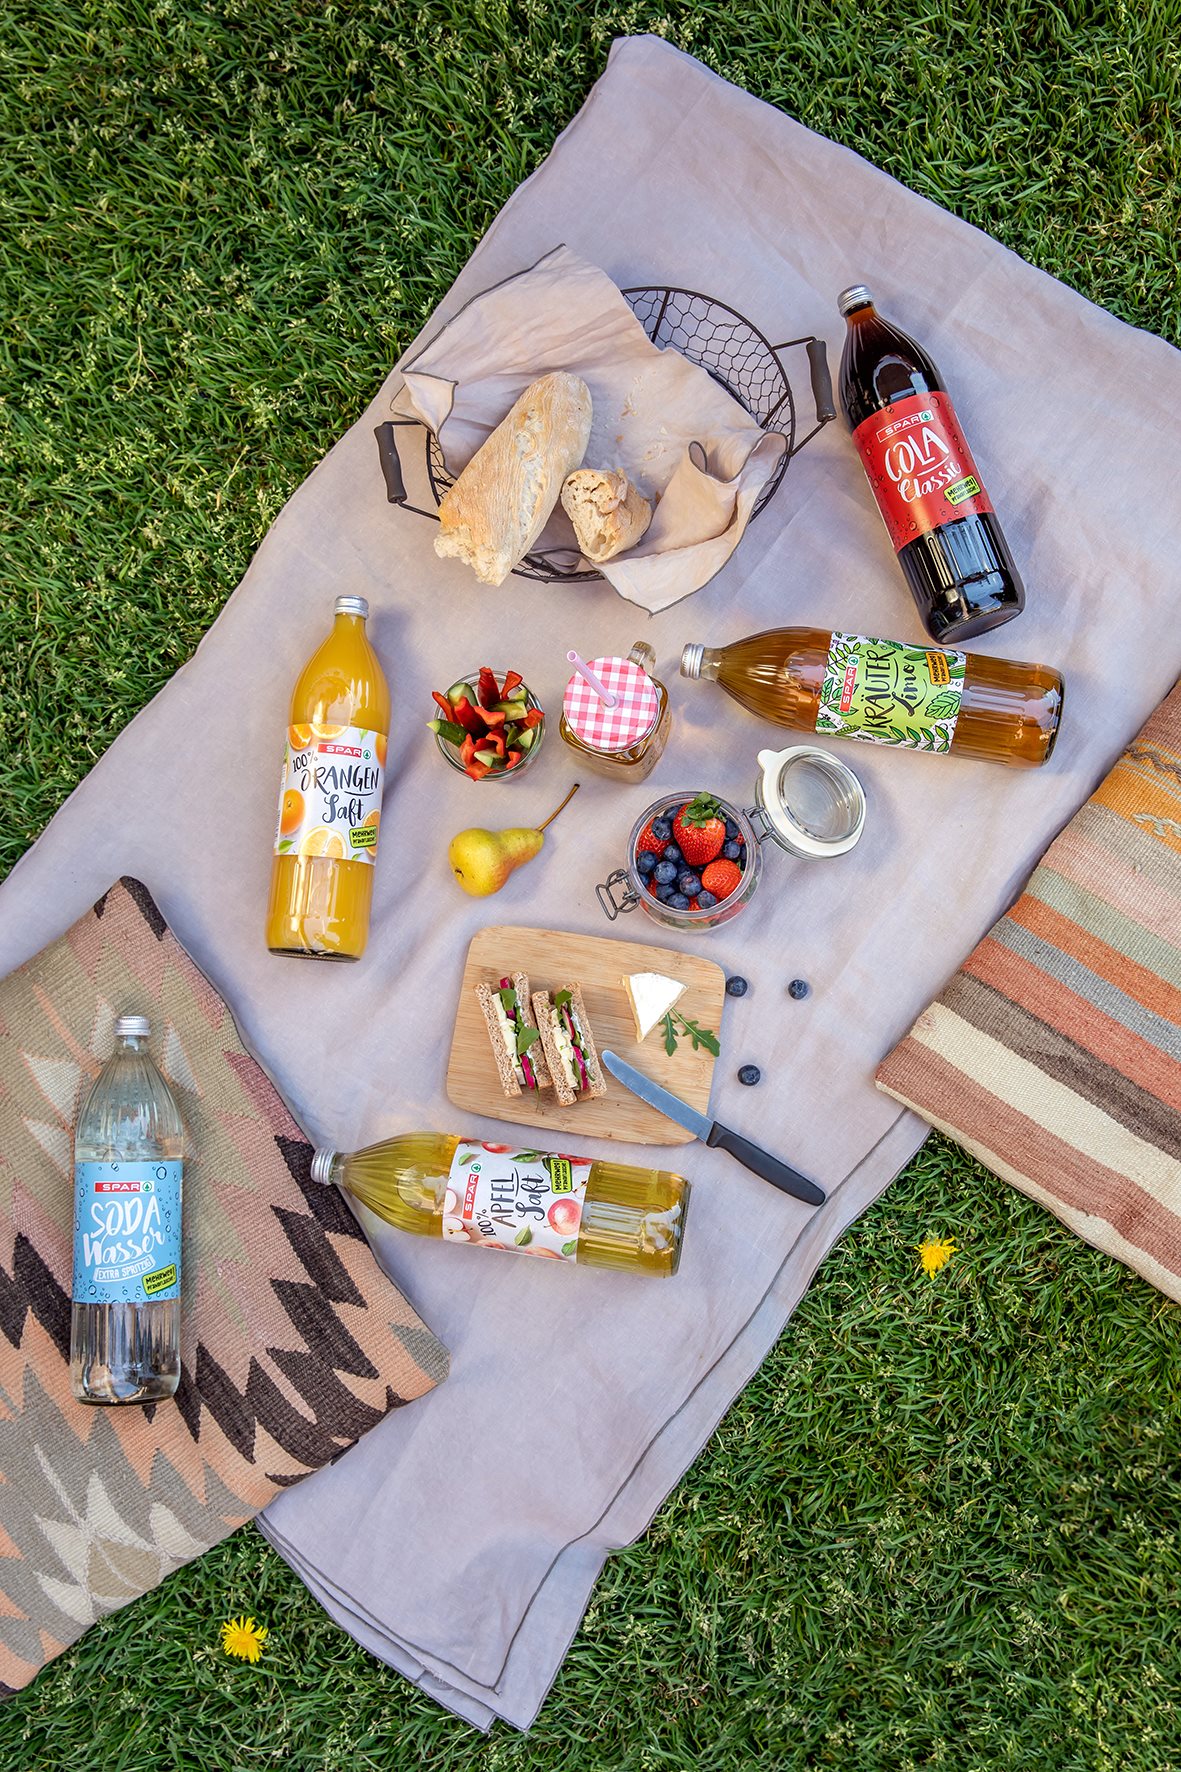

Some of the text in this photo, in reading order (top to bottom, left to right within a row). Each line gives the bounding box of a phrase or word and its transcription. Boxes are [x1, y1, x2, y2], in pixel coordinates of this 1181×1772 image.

[885, 415, 920, 436] SPAR
[884, 426, 950, 482] COLA
[897, 461, 962, 503] Classic
[842, 668, 855, 704] SPAR
[860, 649, 897, 729] KRÄUTER
[891, 663, 927, 717] Limo
[292, 751, 318, 773] 100%
[326, 745, 361, 757] SPAR
[300, 764, 380, 795] ORANGEN
[321, 793, 366, 827] Saft
[102, 1183, 140, 1191] SPAR
[464, 1174, 478, 1211] SPAR
[490, 1172, 517, 1229] APFEL
[514, 1173, 551, 1222] Saft
[90, 1194, 161, 1239] SODA
[475, 1208, 497, 1237] 100%
[83, 1227, 166, 1268] Wasser
[98, 1258, 152, 1280] EXTRA SPRITZIG
